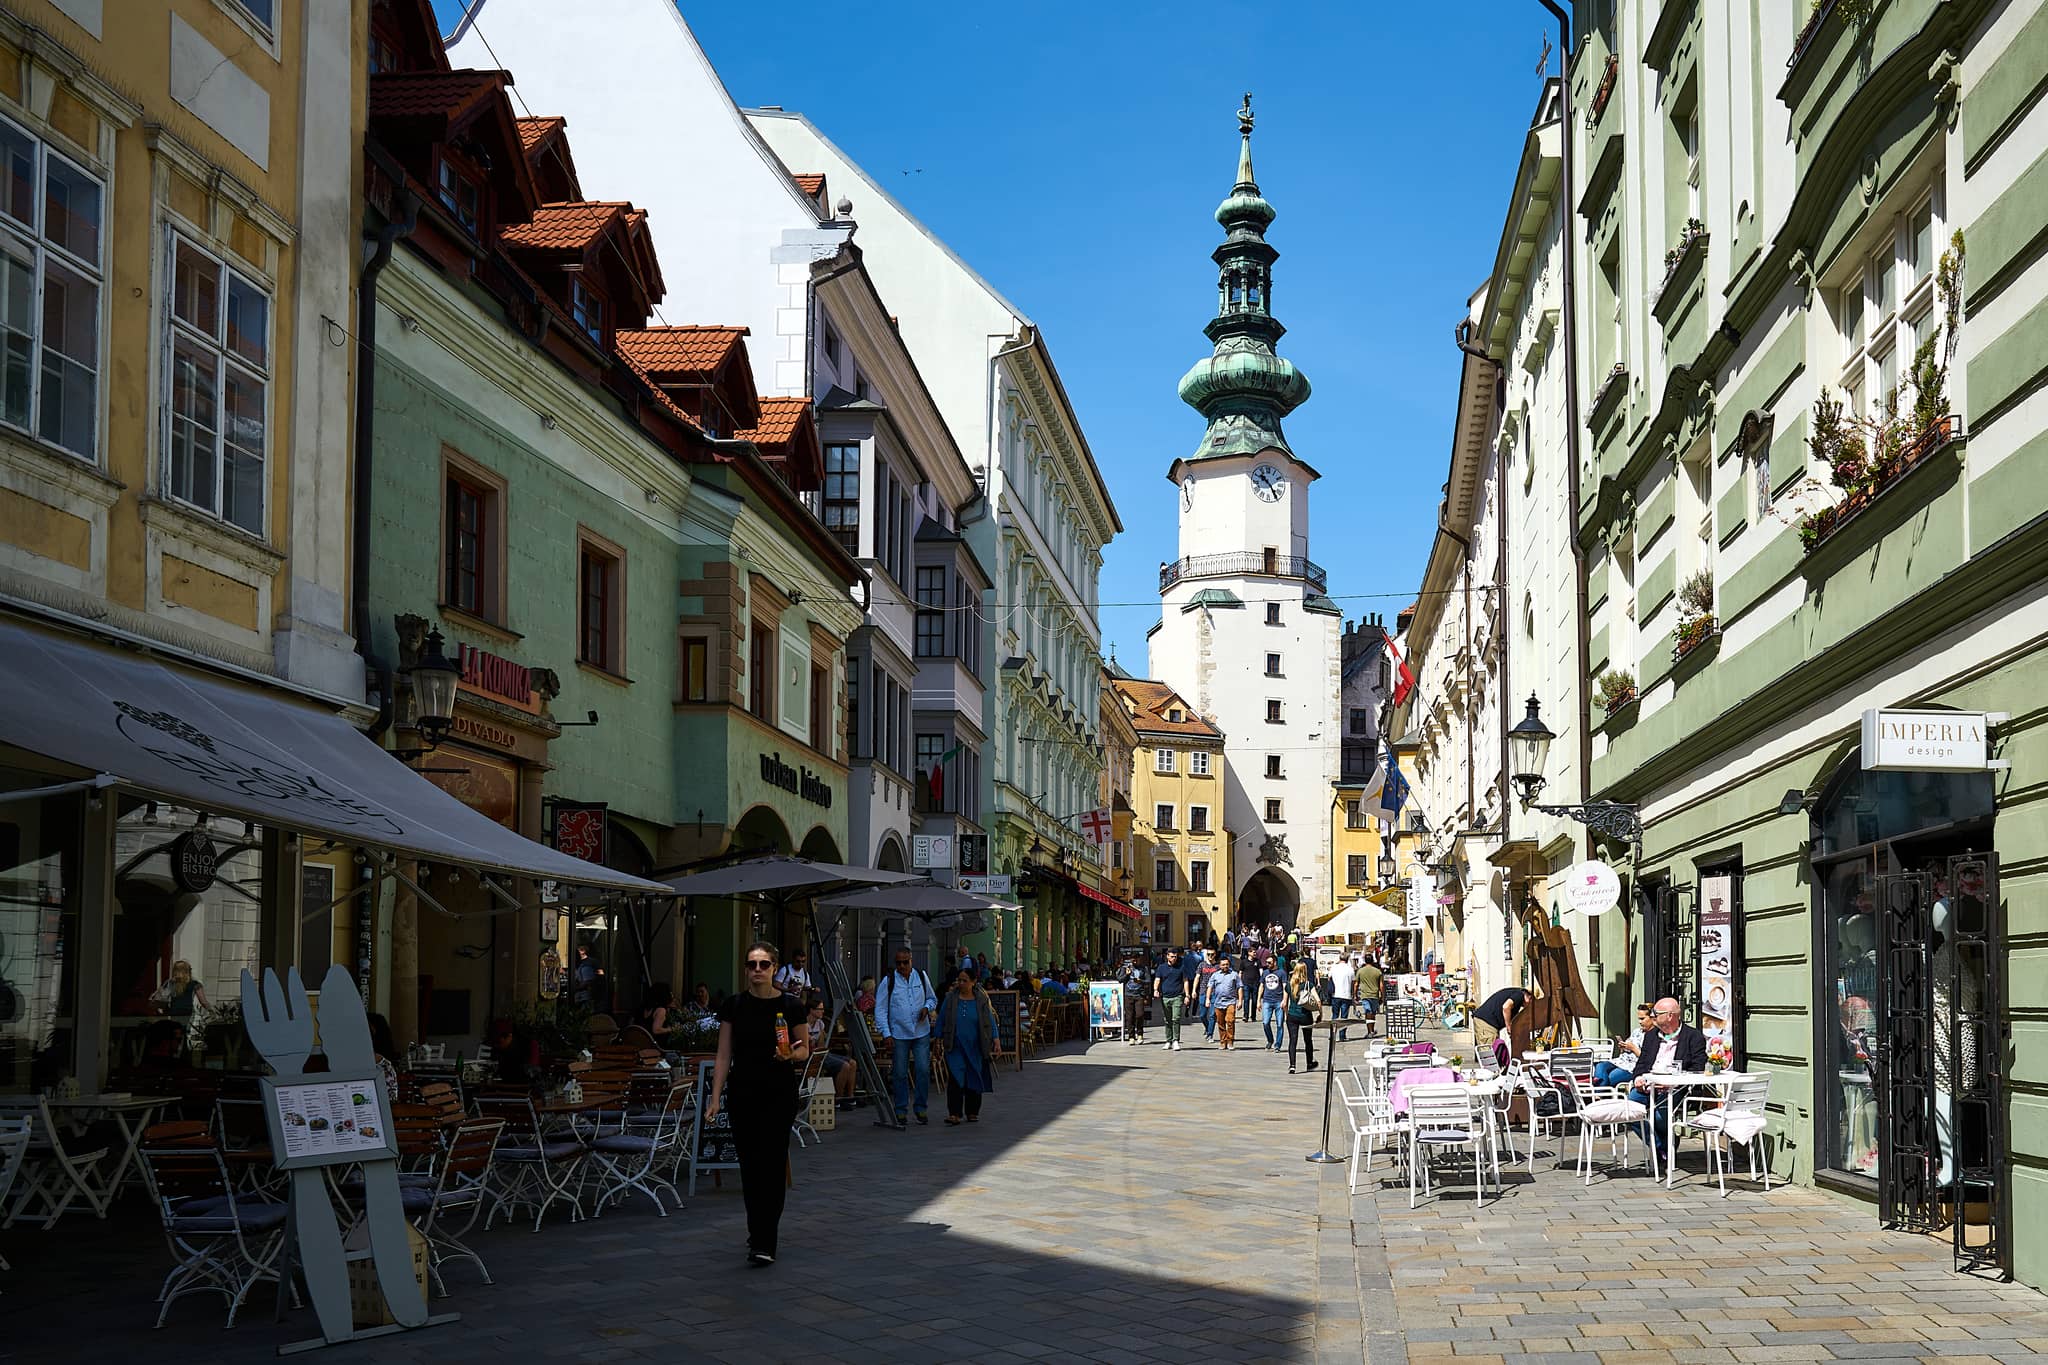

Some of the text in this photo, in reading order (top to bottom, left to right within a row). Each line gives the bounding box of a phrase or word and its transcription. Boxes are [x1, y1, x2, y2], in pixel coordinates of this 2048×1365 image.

[460, 642, 531, 705] LA KOMIKA
[454, 716, 516, 747] DIVADLO
[1880, 722, 1981, 742] IMPERIA
[1908, 745, 1953, 757] design
[760, 752, 832, 809] urban bistro
[183, 853, 216, 866] ENJOY
[183, 863, 217, 876] BISTRO
